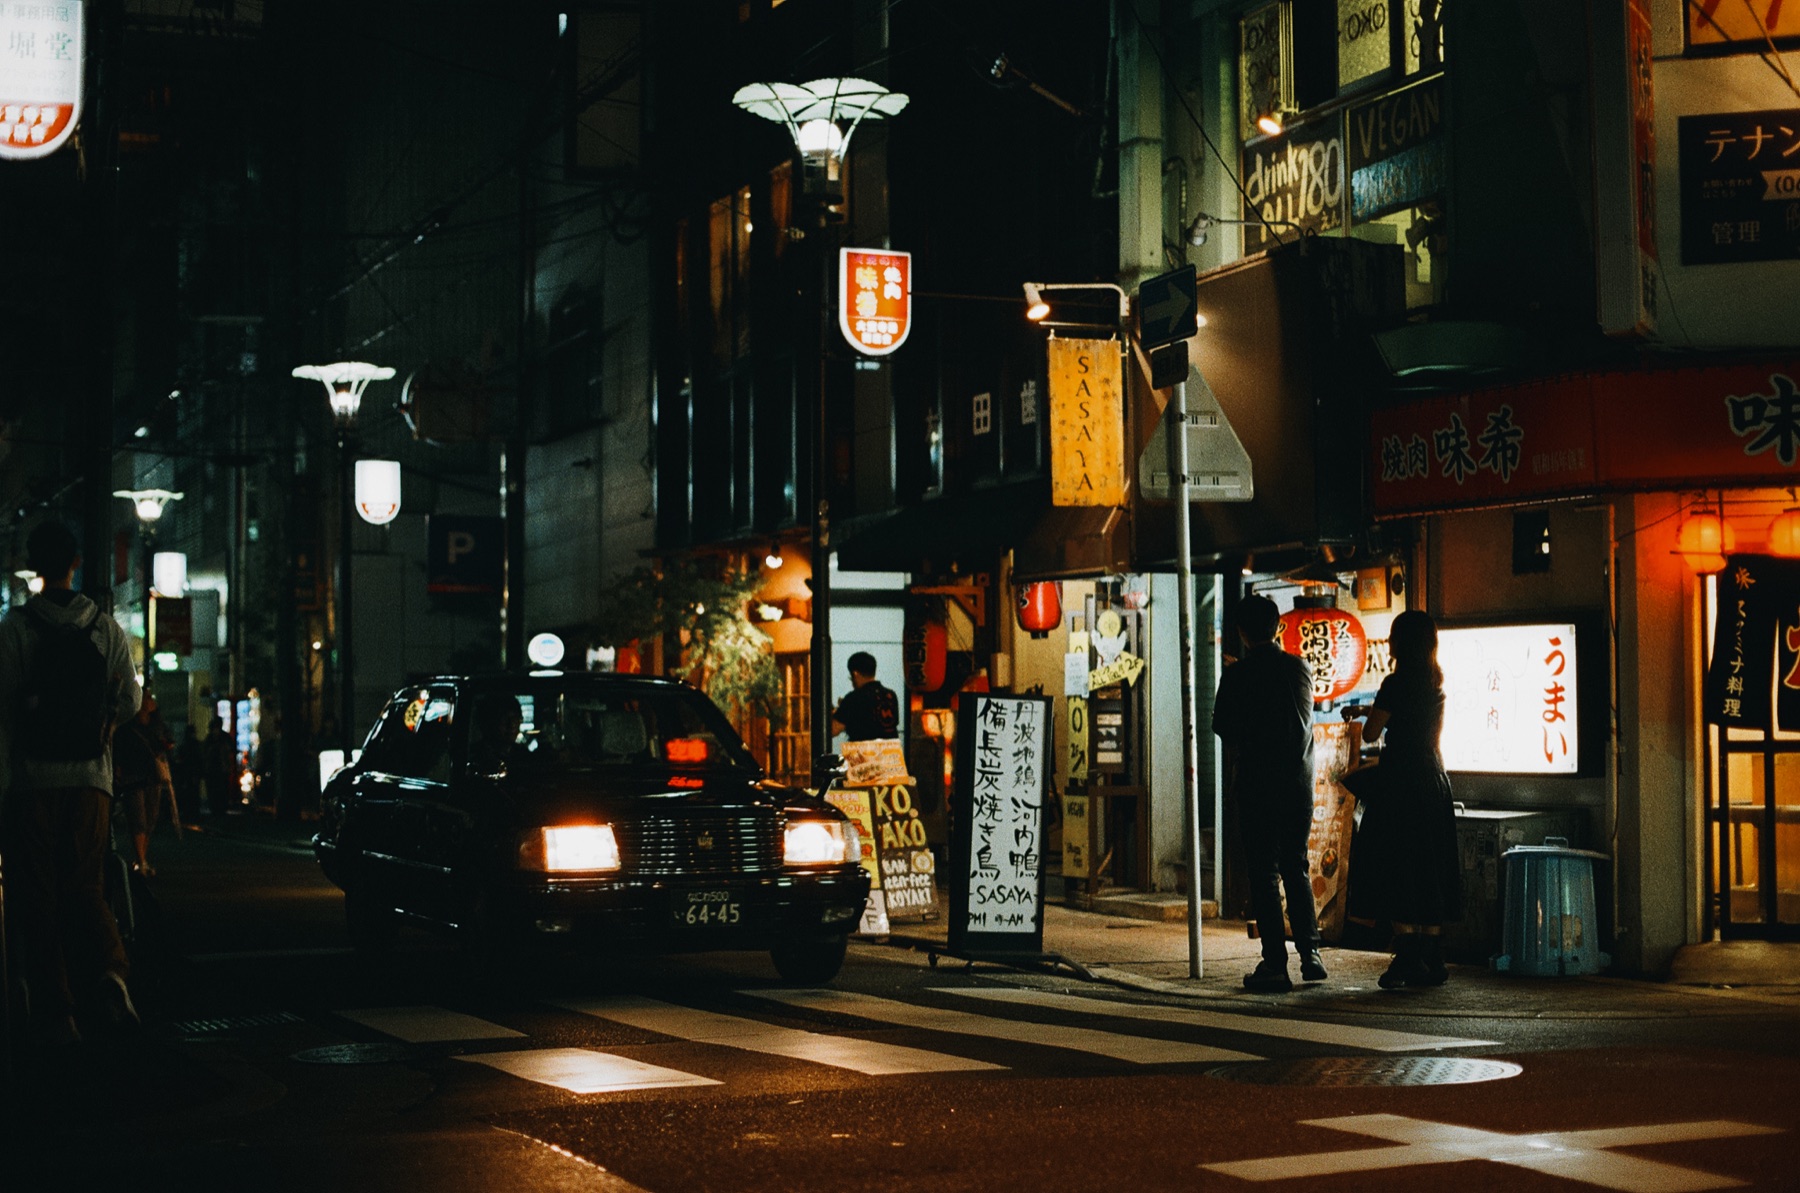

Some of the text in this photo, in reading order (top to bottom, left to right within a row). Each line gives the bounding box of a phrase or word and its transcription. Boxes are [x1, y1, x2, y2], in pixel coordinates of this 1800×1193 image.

[1358, 88, 1440, 160] VEGAN
[1245, 139, 1299, 208] drink
[1711, 221, 1760, 244] 管理
[1075, 356, 1094, 491] SASAYA
[1382, 404, 1525, 486] 焼肉 味希
[1725, 373, 1800, 467] 味
[447, 531, 475, 564] P
[1541, 635, 1569, 765] うまい
[970, 698, 1007, 882] 備長炭焼き鳥
[877, 818, 926, 849] AKO
[685, 903, 740, 925] 64-45
